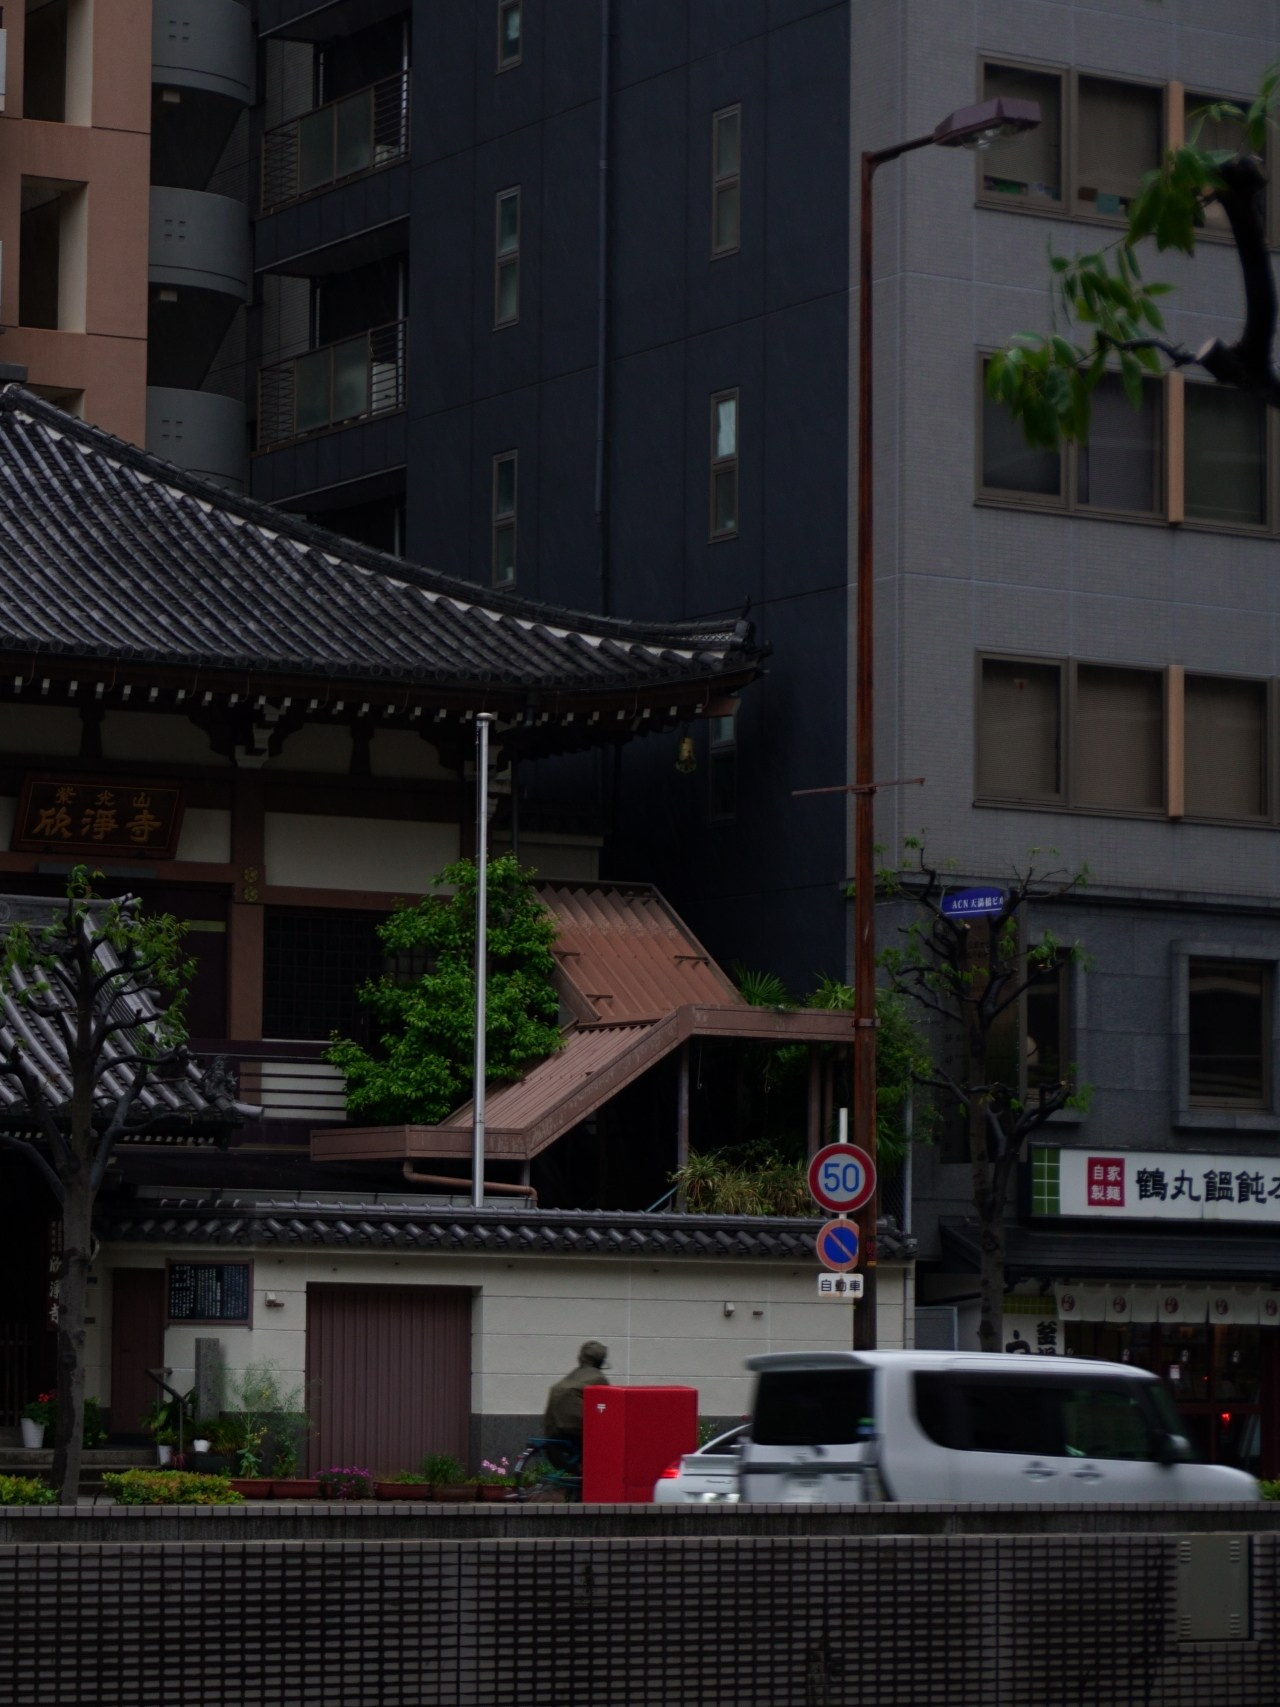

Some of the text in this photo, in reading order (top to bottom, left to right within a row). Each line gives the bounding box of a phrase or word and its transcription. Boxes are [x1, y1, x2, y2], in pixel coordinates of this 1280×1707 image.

[824, 1163, 860, 1192] 50
[1092, 1164, 1121, 1181] 自家
[821, 1279, 861, 1292] 自動車
